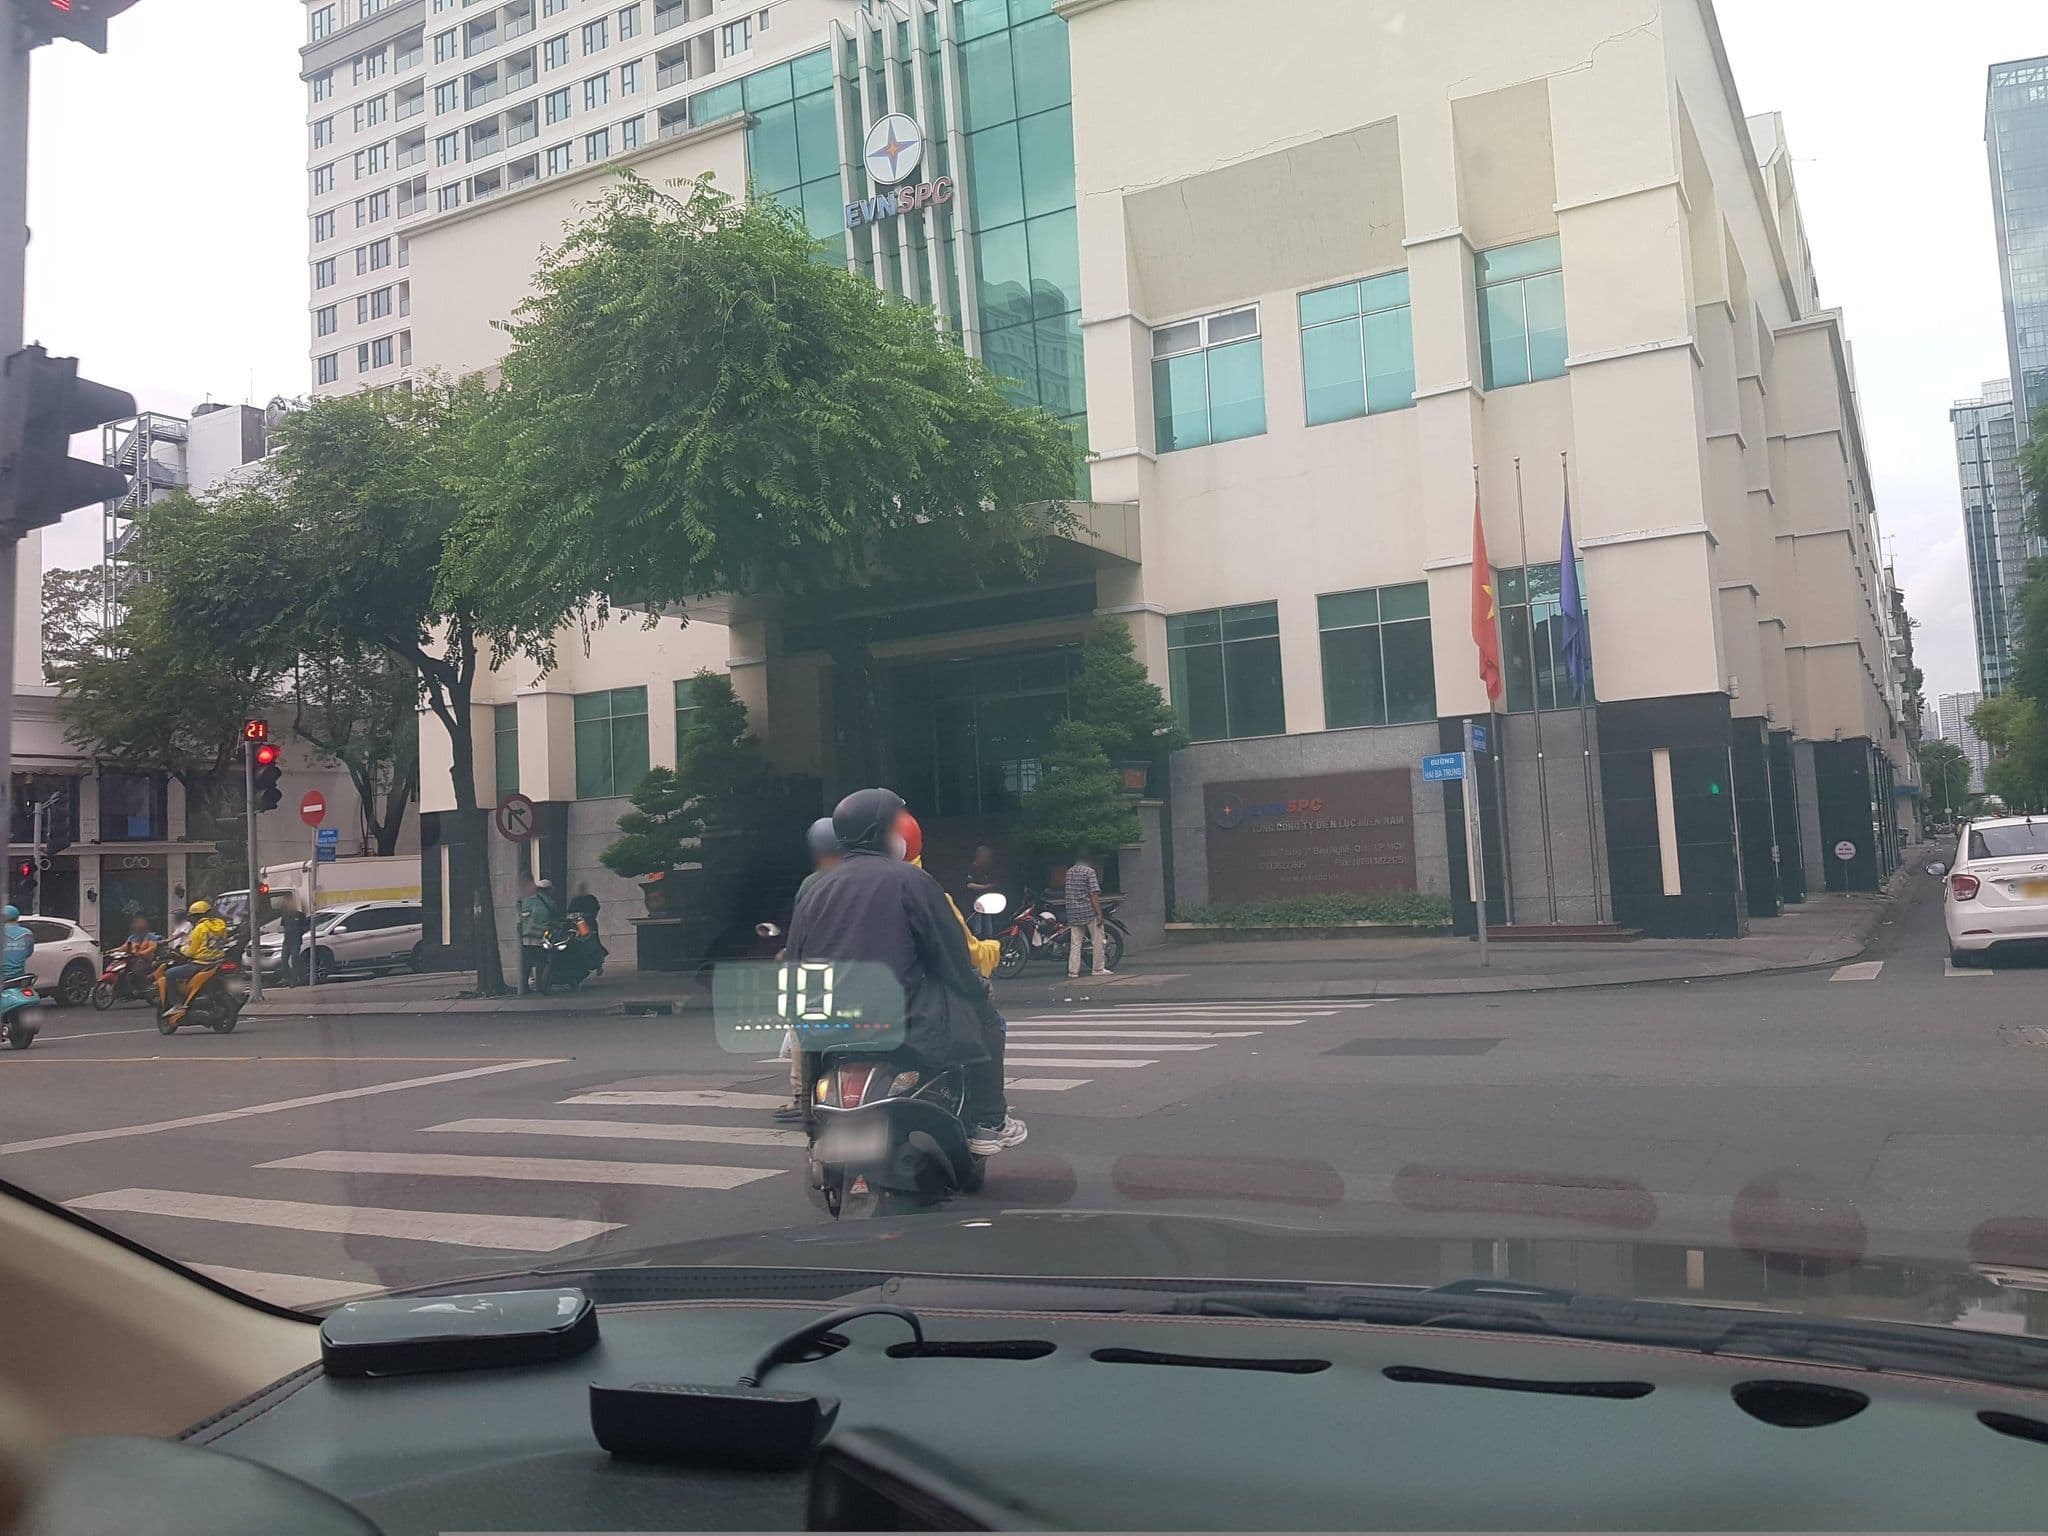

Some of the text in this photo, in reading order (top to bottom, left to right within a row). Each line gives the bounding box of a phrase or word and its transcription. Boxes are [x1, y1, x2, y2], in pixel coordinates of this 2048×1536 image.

[845, 175, 953, 229] EVNSPC
[247, 723, 263, 737] 21
[777, 962, 834, 1020] 10
